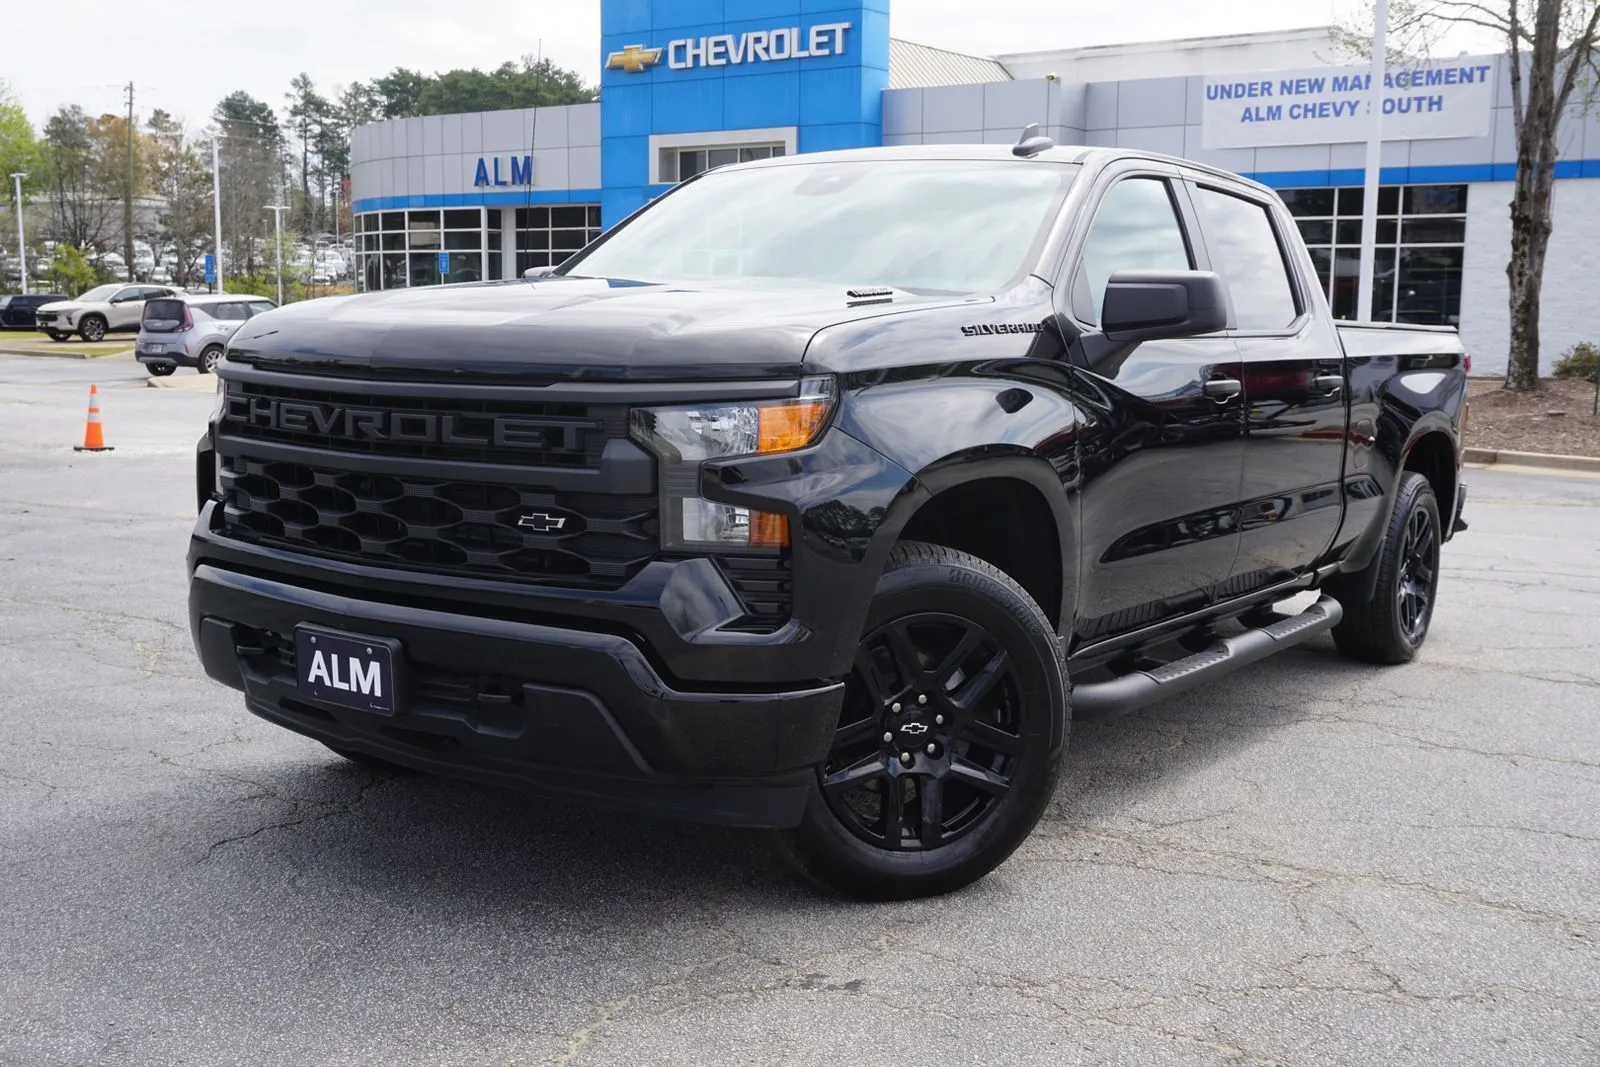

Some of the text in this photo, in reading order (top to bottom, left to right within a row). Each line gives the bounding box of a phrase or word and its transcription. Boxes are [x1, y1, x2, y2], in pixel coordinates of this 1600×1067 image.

[668, 22, 851, 69] CHEVROLET
[1206, 81, 1273, 100] UNDER
[1279, 77, 1325, 96] NEW
[1240, 95, 1443, 123] ALM CHEVY OUTH
[474, 156, 532, 187] ALM
[226, 396, 600, 450] CHEVROLET
[307, 650, 382, 698] ALM
